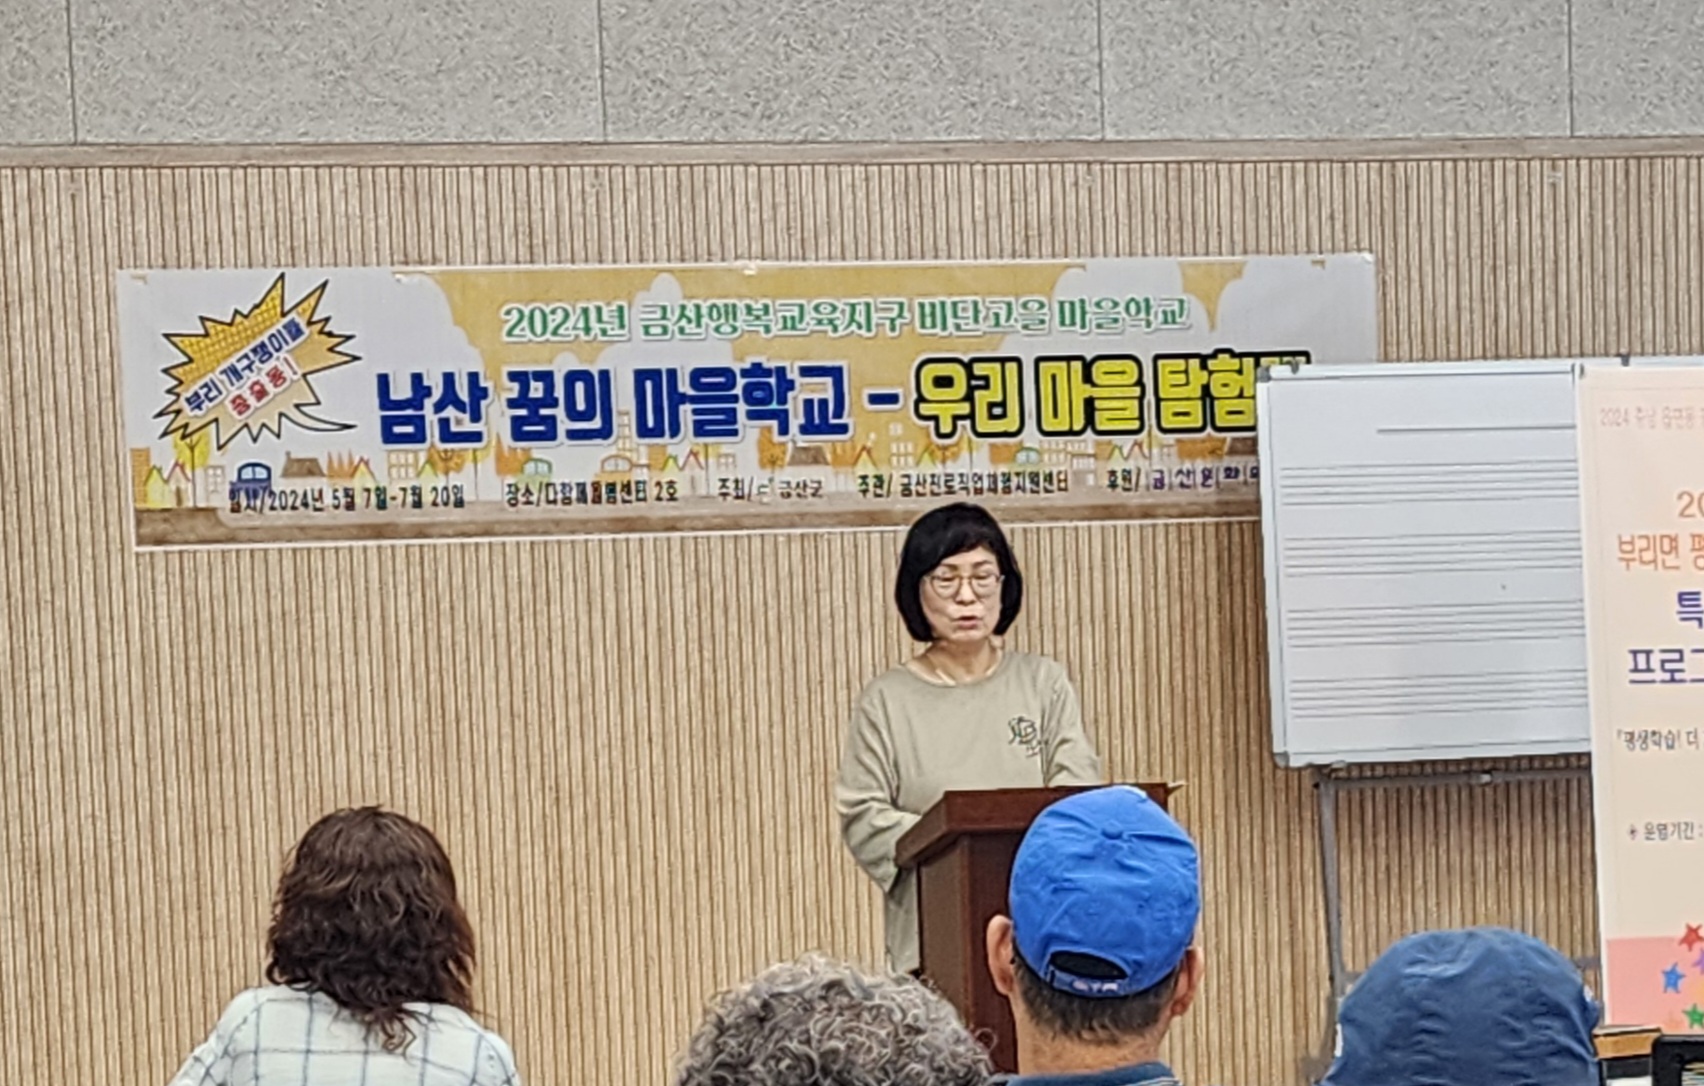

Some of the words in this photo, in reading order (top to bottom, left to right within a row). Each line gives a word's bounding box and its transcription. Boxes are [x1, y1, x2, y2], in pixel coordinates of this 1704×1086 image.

[502, 303, 627, 338] 2024년
[639, 300, 907, 337] 금산행복교육지구
[917, 298, 1049, 333] 비단고을
[1057, 297, 1188, 332] 마을학교
[184, 377, 223, 412] 부리
[377, 371, 489, 445] 남산
[506, 368, 612, 442] 꿈의
[633, 362, 850, 438] 마을학교
[916, 359, 1022, 437] 우리
[1037, 357, 1143, 433] 마을
[1155, 351, 1307, 430] 탐험
[1600, 406, 1630, 427] 2024
[332, 486, 355, 510] 5월
[430, 484, 465, 508] 20일
[654, 478, 679, 501] 2호
[1617, 533, 1681, 571] 부리면
[1686, 728, 1699, 750] 더
